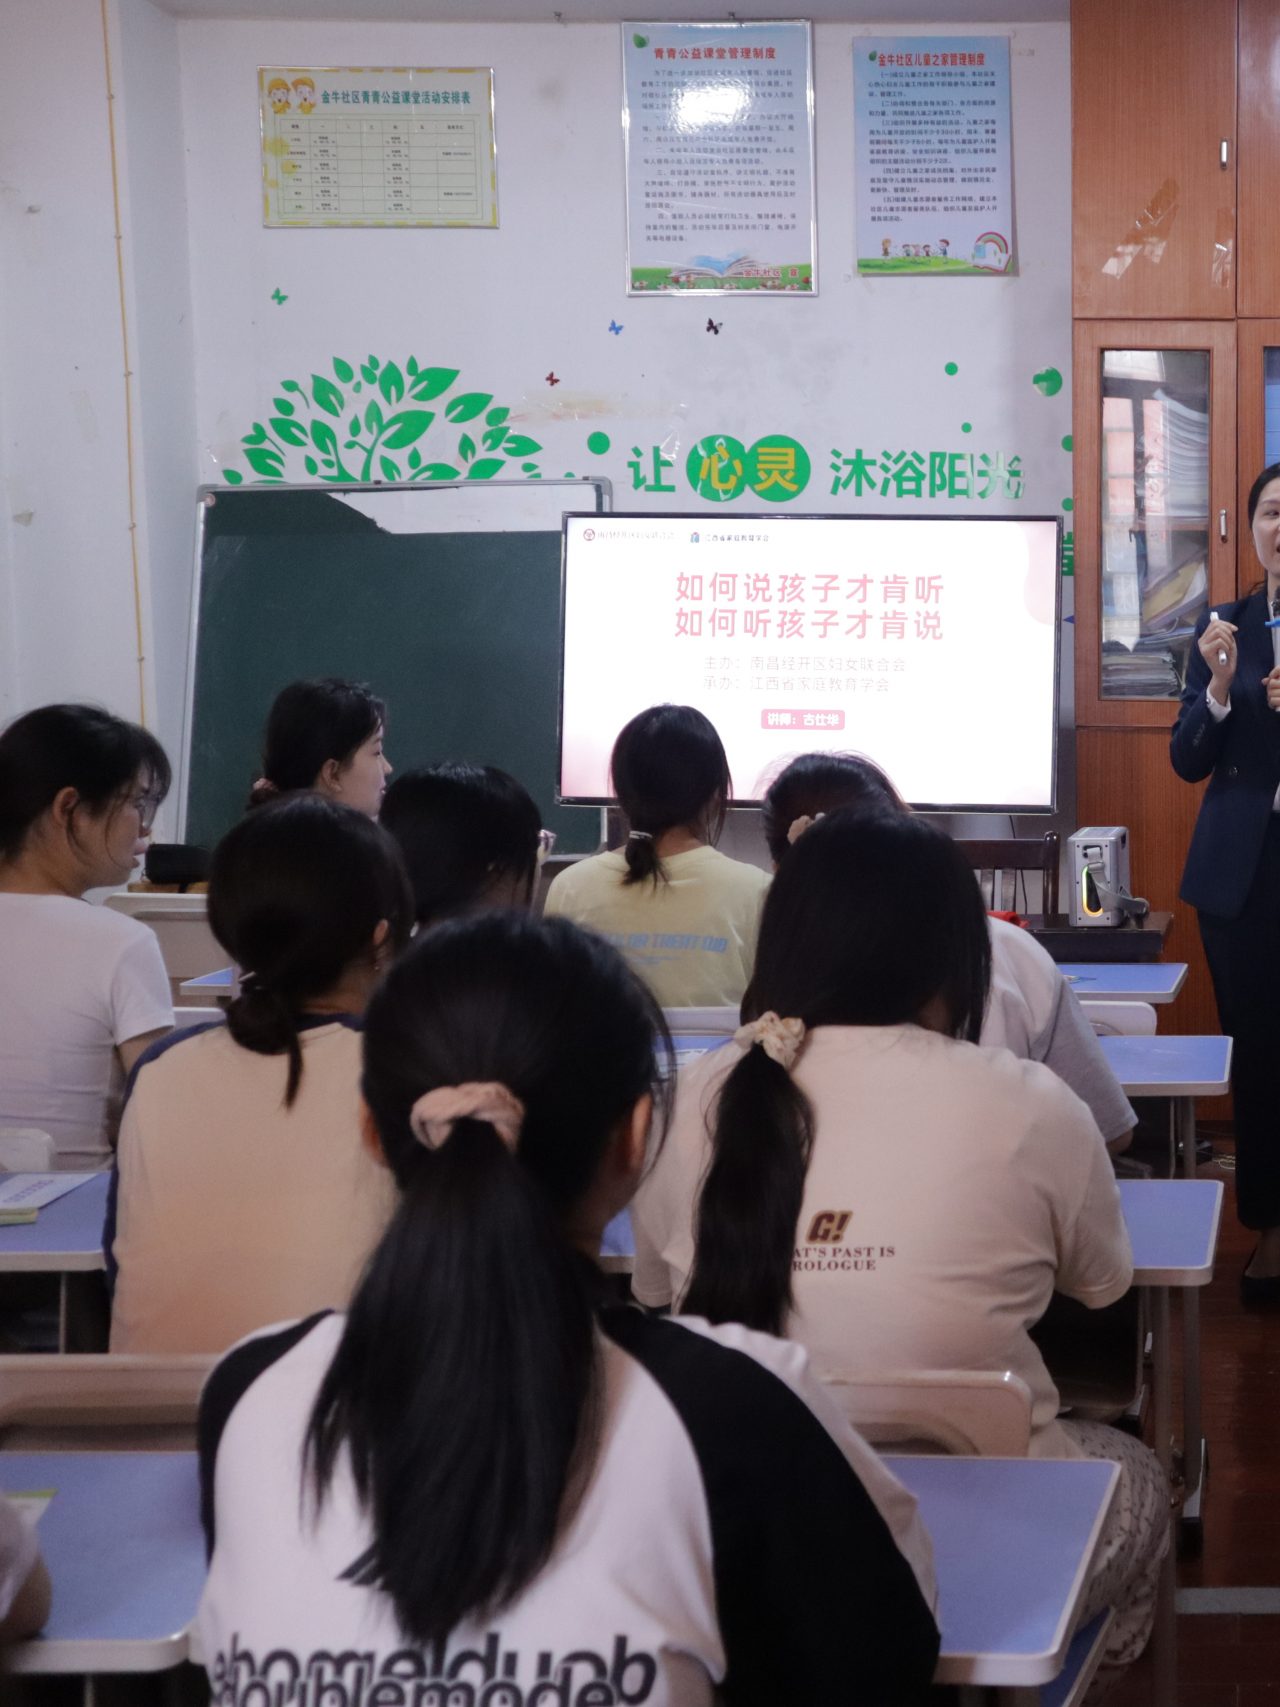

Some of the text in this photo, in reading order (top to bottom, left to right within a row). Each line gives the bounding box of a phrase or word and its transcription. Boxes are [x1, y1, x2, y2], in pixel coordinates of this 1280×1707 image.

[878, 53, 985, 67] 金牛社区儿童之家管理制度
[675, 571, 945, 605] 如何说孩子才肯听
[674, 607, 944, 641] 如何听孩子才肯说
[793, 1246, 895, 1258] AT'S PAST IS
[793, 1260, 876, 1272] ROLOGUE
